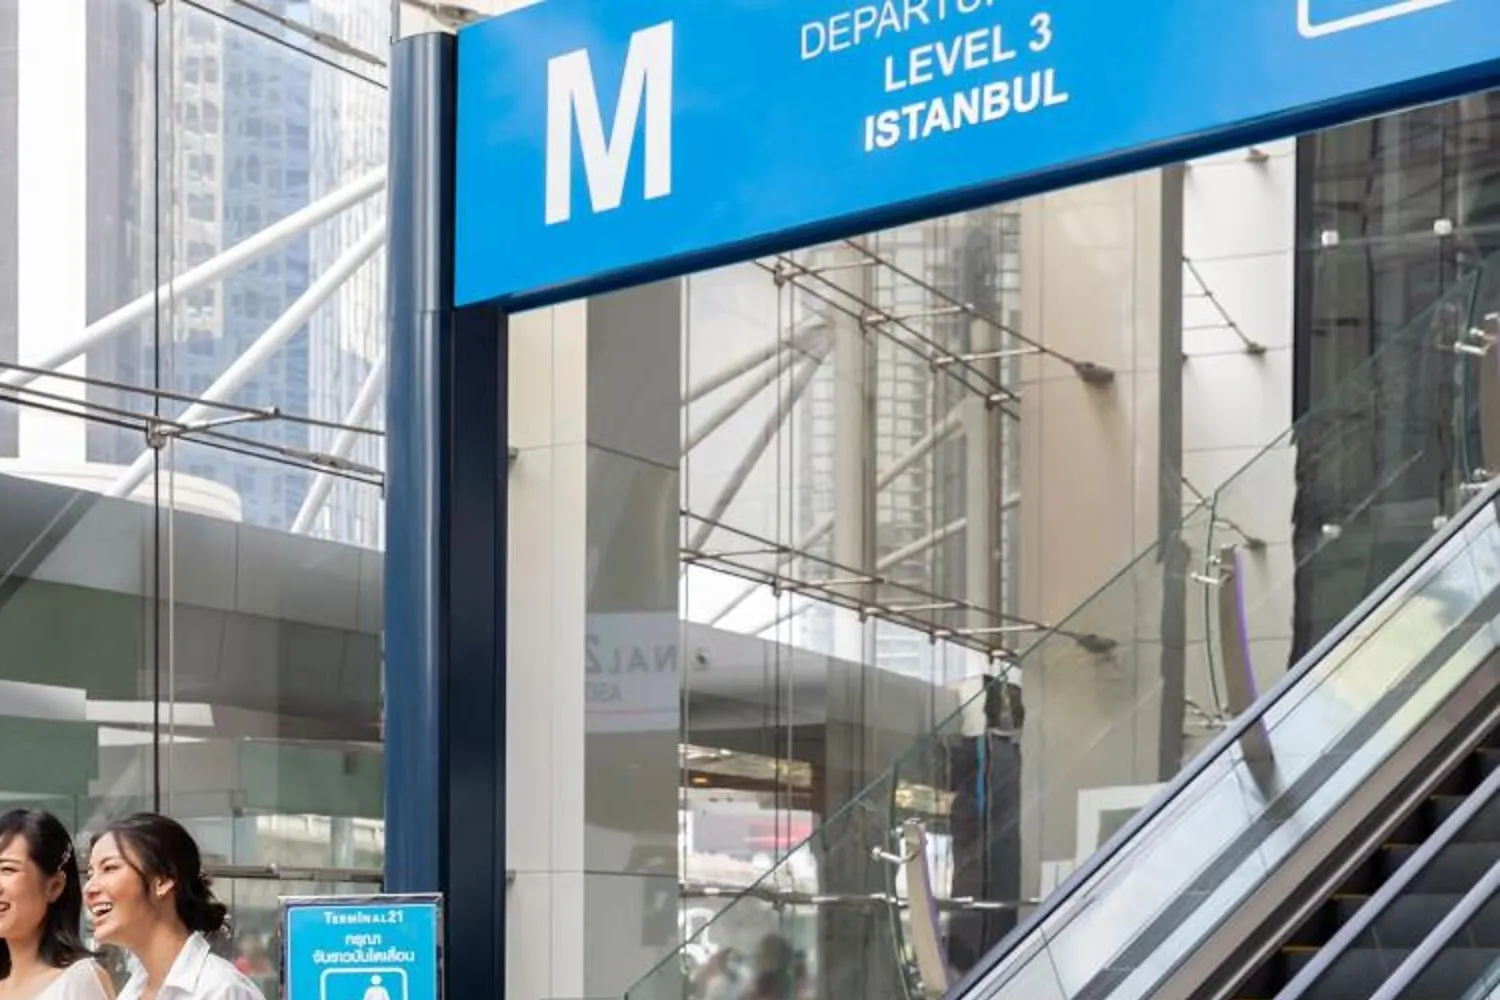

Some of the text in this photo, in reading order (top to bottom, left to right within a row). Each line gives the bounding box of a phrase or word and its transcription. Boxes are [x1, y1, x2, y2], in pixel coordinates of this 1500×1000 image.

[801, 0, 993, 60] DEPAR
[884, 12, 1052, 92] LEVEL 3
[544, 20, 673, 226] M
[864, 68, 1069, 151] ISTANBUL
